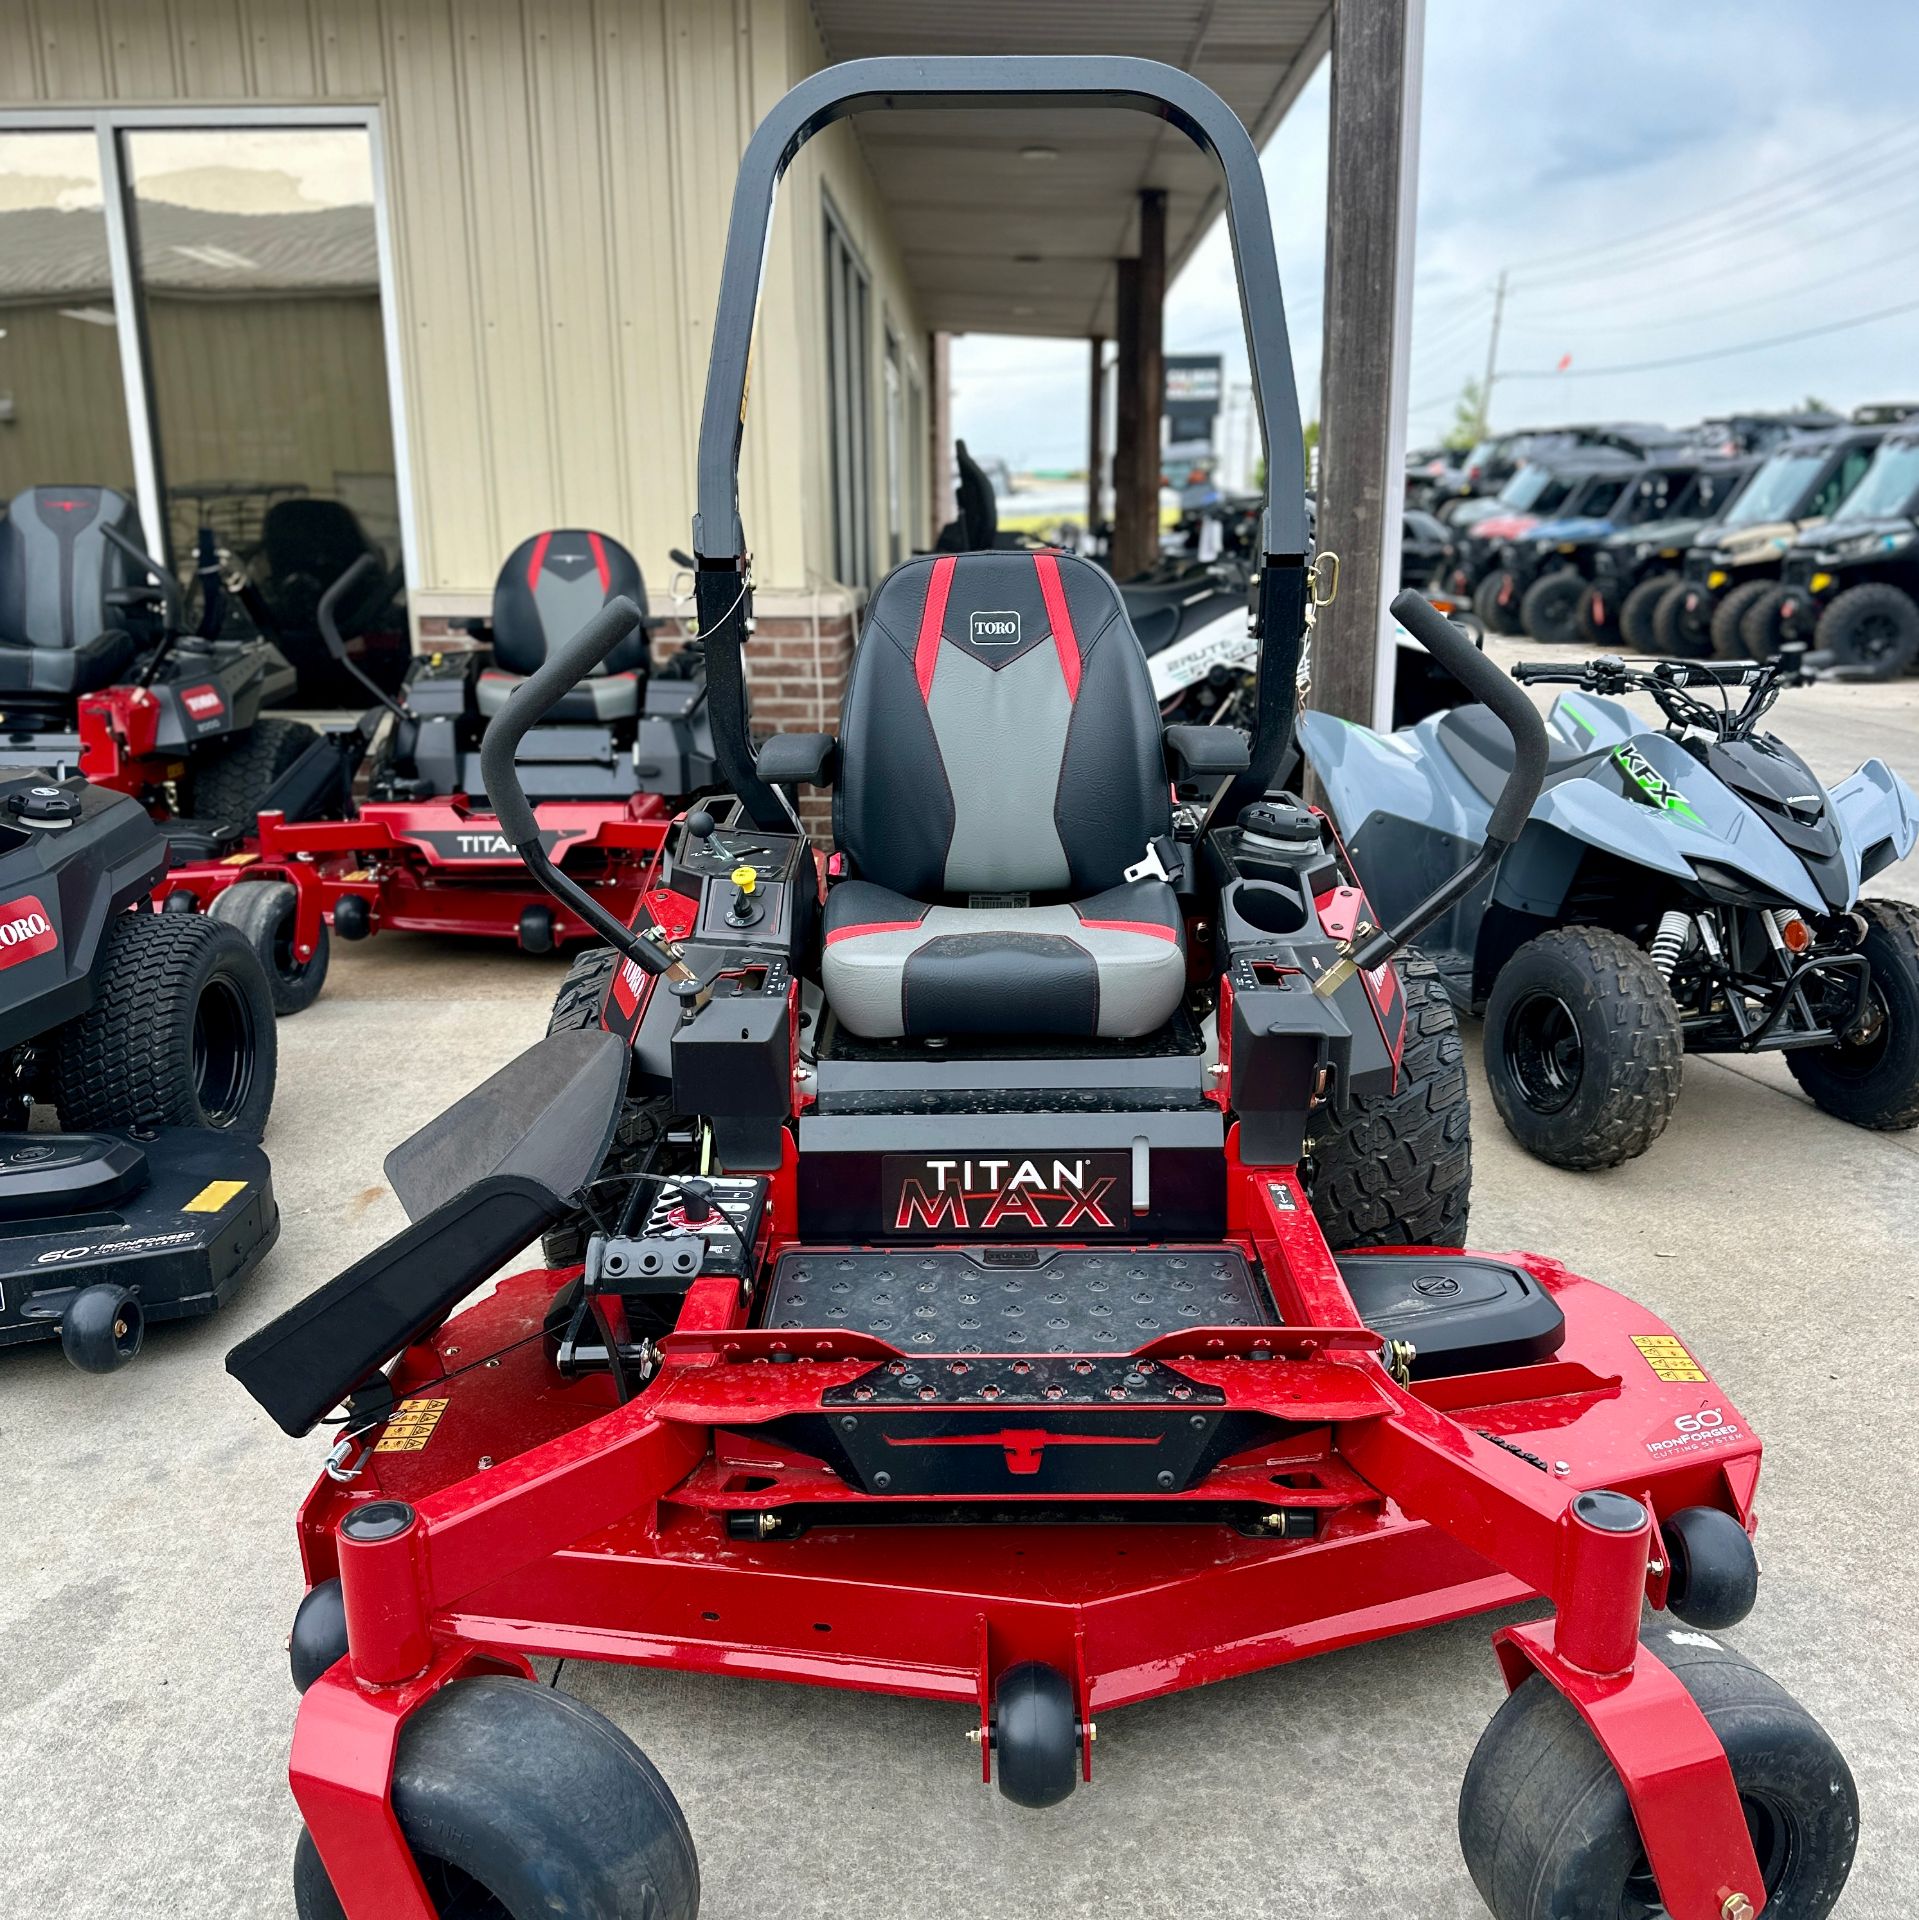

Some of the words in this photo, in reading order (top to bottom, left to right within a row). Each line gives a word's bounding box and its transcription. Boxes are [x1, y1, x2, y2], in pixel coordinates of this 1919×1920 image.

[974, 621, 1016, 635] TORO
[1617, 742, 1690, 809] KFX
[894, 1178, 1117, 1228] MAX
[93, 1244, 142, 1255] CUTTING
[147, 1237, 191, 1248] SYSTEM
[99, 1231, 195, 1251] IRONFORGED
[1646, 1424, 1738, 1453] IRONFORGED
[1653, 1443, 1699, 1459] CUTTING
[1701, 1433, 1744, 1448] SYSTEM
